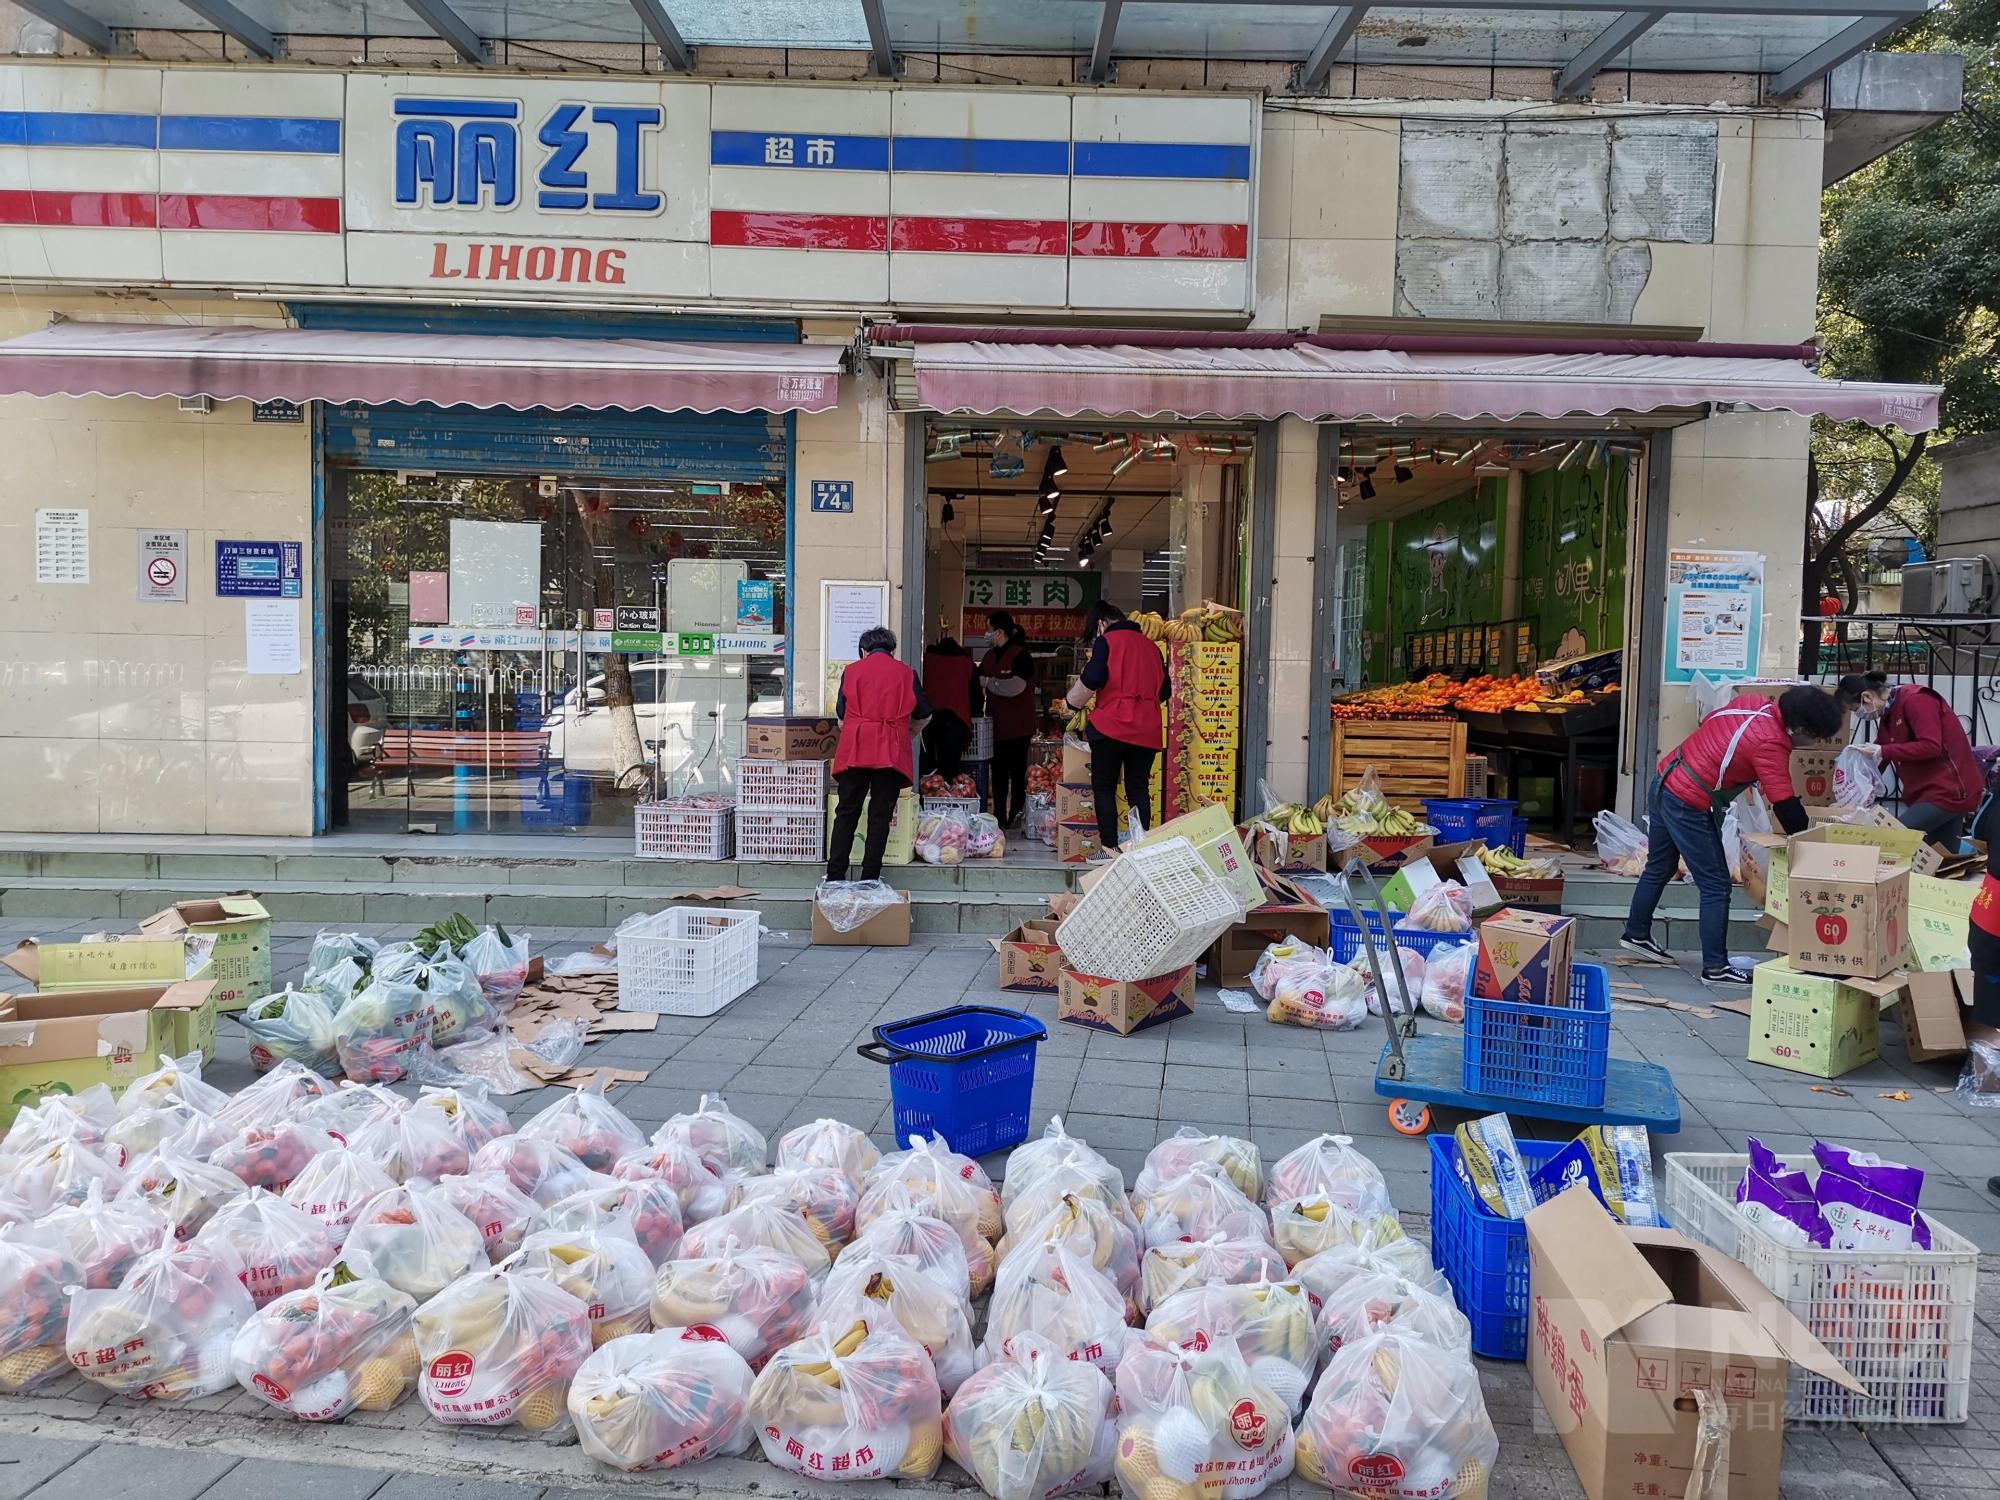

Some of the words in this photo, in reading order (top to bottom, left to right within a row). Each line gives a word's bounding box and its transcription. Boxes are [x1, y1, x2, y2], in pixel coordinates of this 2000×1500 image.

[394, 97, 661, 212] 丽红
[764, 136, 836, 165] 超市
[429, 243, 627, 284] LIHONG
[817, 492, 842, 509] 74
[969, 580, 1069, 606] 冷鲜肉
[619, 610, 658, 620] 小心玻璃
[728, 640, 767, 649] LIHONG
[1832, 859, 1846, 868] 36
[1800, 890, 1864, 905] 冷藏专用
[1823, 924, 1840, 937] 60
[1799, 951, 1864, 966] 超市特供
[220, 990, 235, 1001] 60
[1775, 1045, 1792, 1057] 60
[436, 1362, 470, 1377] 丽红
[435, 1379, 466, 1389] LIHONG
[785, 1436, 875, 1472] 丽红超市
[1359, 1463, 1395, 1478] 丽红
